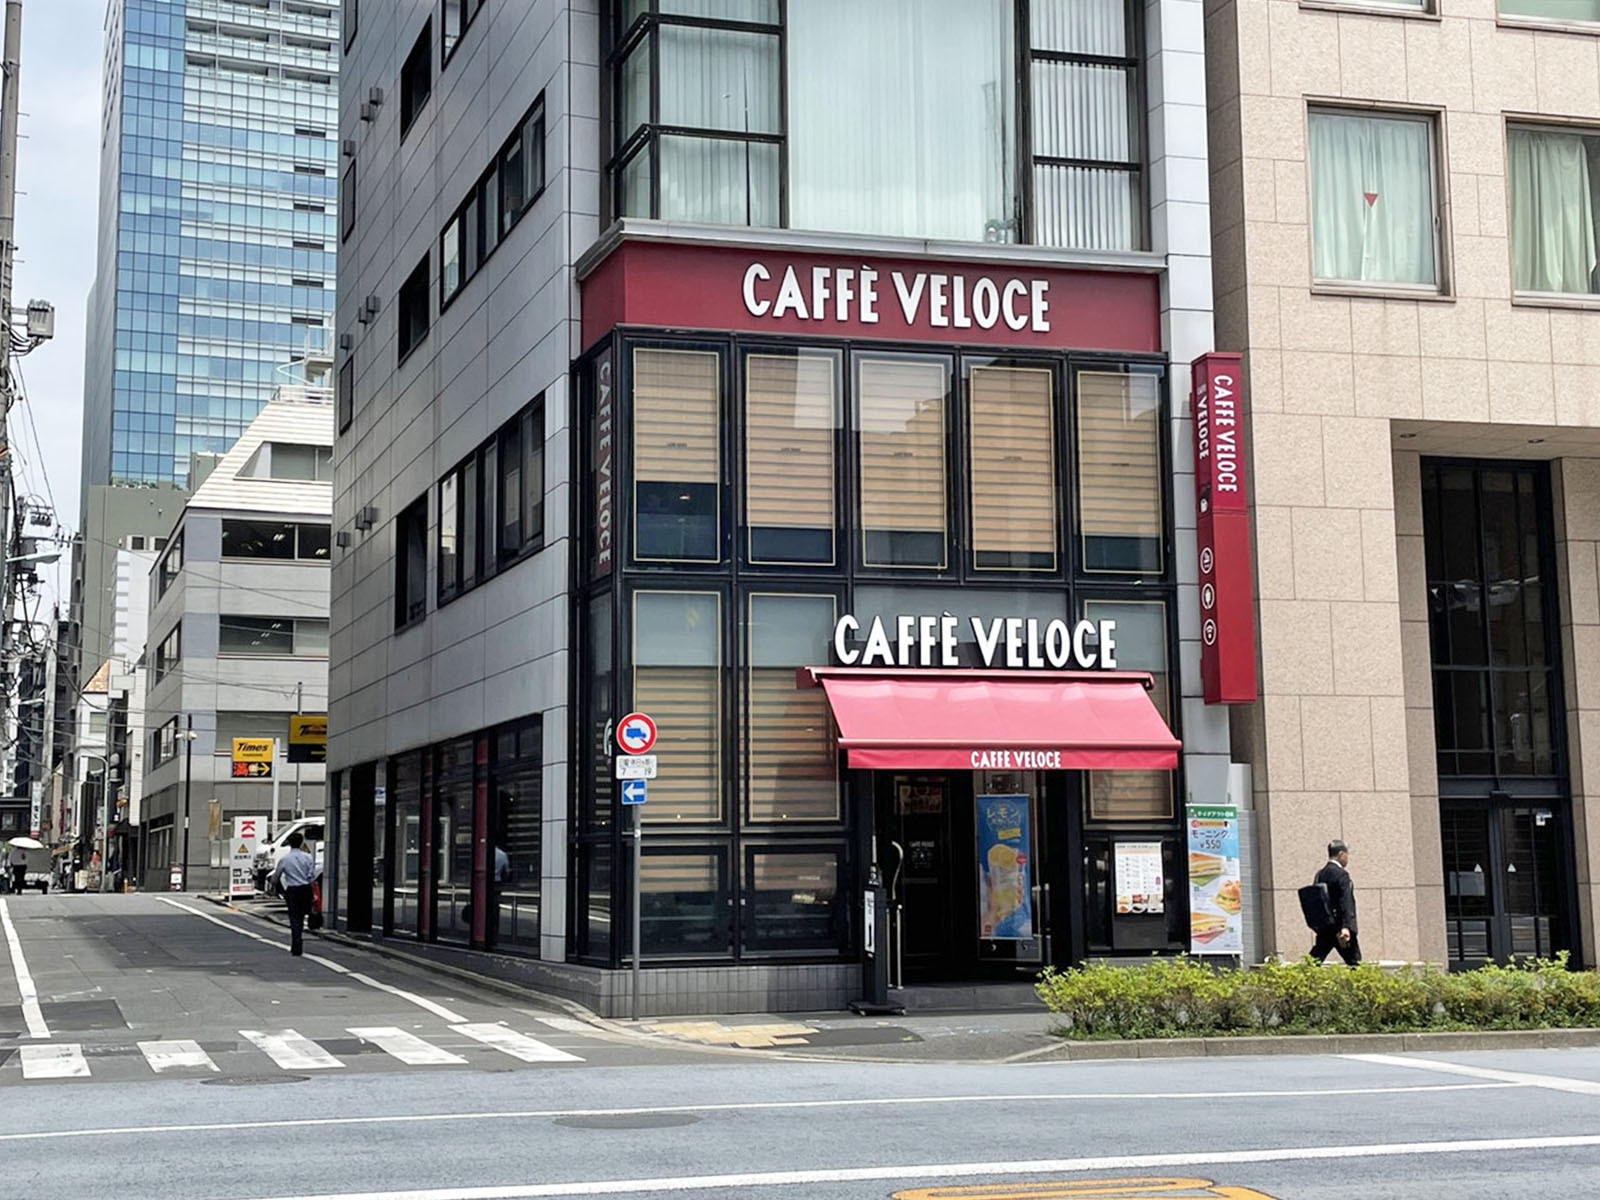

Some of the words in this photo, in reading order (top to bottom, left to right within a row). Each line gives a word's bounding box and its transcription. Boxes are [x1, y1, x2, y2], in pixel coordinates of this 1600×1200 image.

[743, 262, 880, 323] CAFFÈ
[892, 271, 1050, 333] VELOCE
[1197, 396, 1210, 460] VELOCE
[1216, 430, 1238, 492] VELOCE
[599, 454, 612, 564] VELOCE
[834, 611, 960, 667] CAFFÈ
[970, 616, 1118, 670] VELOCE
[237, 742, 268, 751] Times
[1013, 750, 1061, 768] VELOCE
